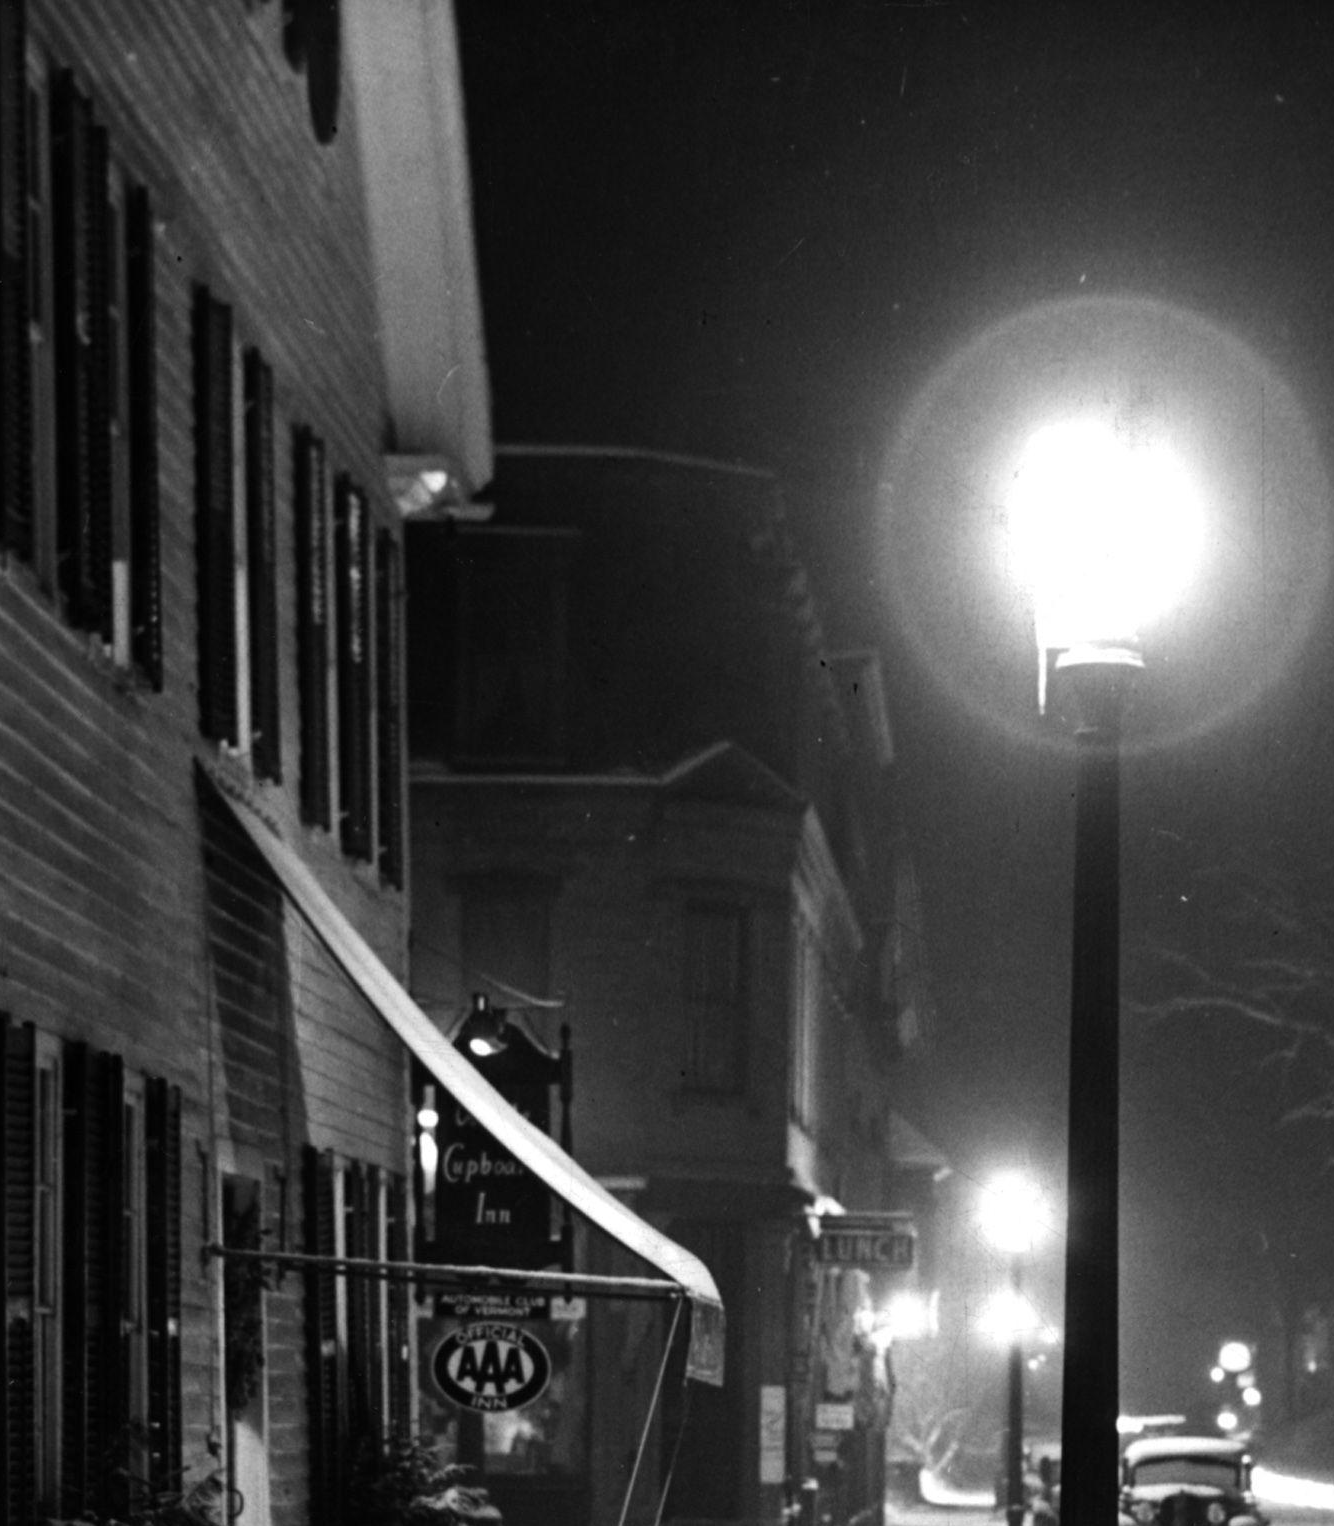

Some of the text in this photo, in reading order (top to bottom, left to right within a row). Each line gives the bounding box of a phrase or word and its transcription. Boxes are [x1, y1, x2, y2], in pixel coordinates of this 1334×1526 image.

[442, 1142, 524, 1183] Cupboa
[475, 1191, 512, 1225] Inn
[822, 1236, 910, 1262] LUNCH
[441, 1294, 546, 1307] AUTOMOBILE CLUB
[454, 1305, 531, 1316] OF VERMONT
[455, 1325, 525, 1348] OFFICIAL
[456, 1341, 525, 1394] AAA
[471, 1396, 508, 1408] INN
